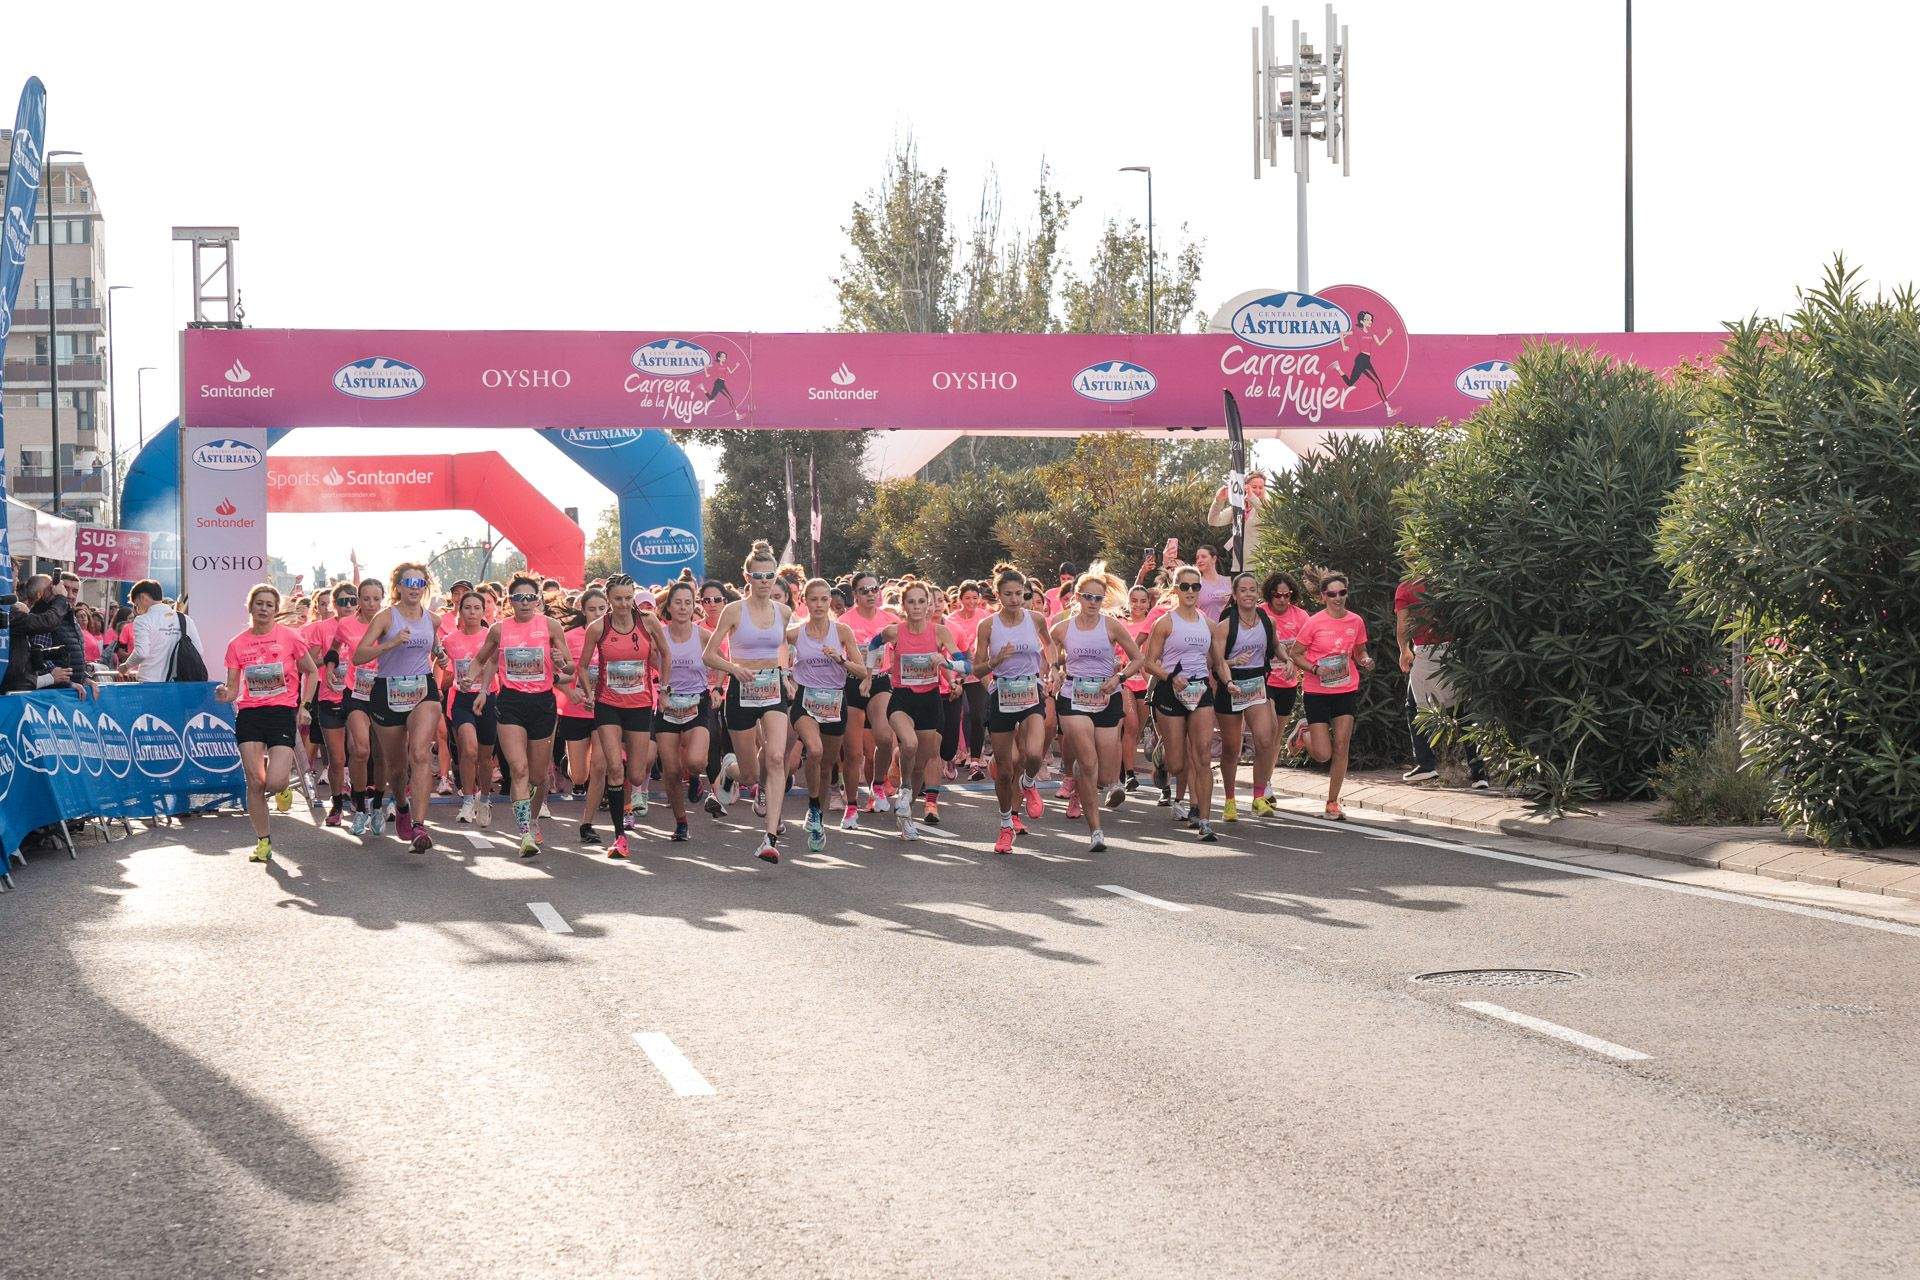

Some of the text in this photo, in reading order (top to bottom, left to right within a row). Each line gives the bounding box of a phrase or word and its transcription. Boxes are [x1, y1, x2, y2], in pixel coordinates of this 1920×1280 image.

[1240, 312, 1341, 334] ASTURIANA
[638, 352, 705, 367] ASTURIANA
[1220, 345, 1320, 376] Carrera
[341, 372, 418, 388] ASTURIANA
[482, 369, 571, 388] OYSHO
[624, 372, 691, 394] Carrera
[932, 371, 1017, 391] OYSHO
[1080, 375, 1151, 391] ASTURIANA
[1462, 375, 1507, 390] ASTURI
[201, 385, 275, 398] Santander
[808, 387, 879, 400] Santander
[1245, 372, 1356, 423] de la Mujer
[640, 391, 716, 424] de la Mujer
[568, 428, 638, 440] ASTURIANA
[197, 451, 257, 463] ASTURIANA
[267, 469, 434, 490] Sports Santander
[196, 517, 256, 528] Santander
[81, 531, 117, 548] SUB
[635, 541, 696, 556] ASTURIANA
[192, 555, 263, 571] OYSHO
[134, 736, 182, 761] ASTURIANA
[188, 735, 241, 758] ASTURIANA
